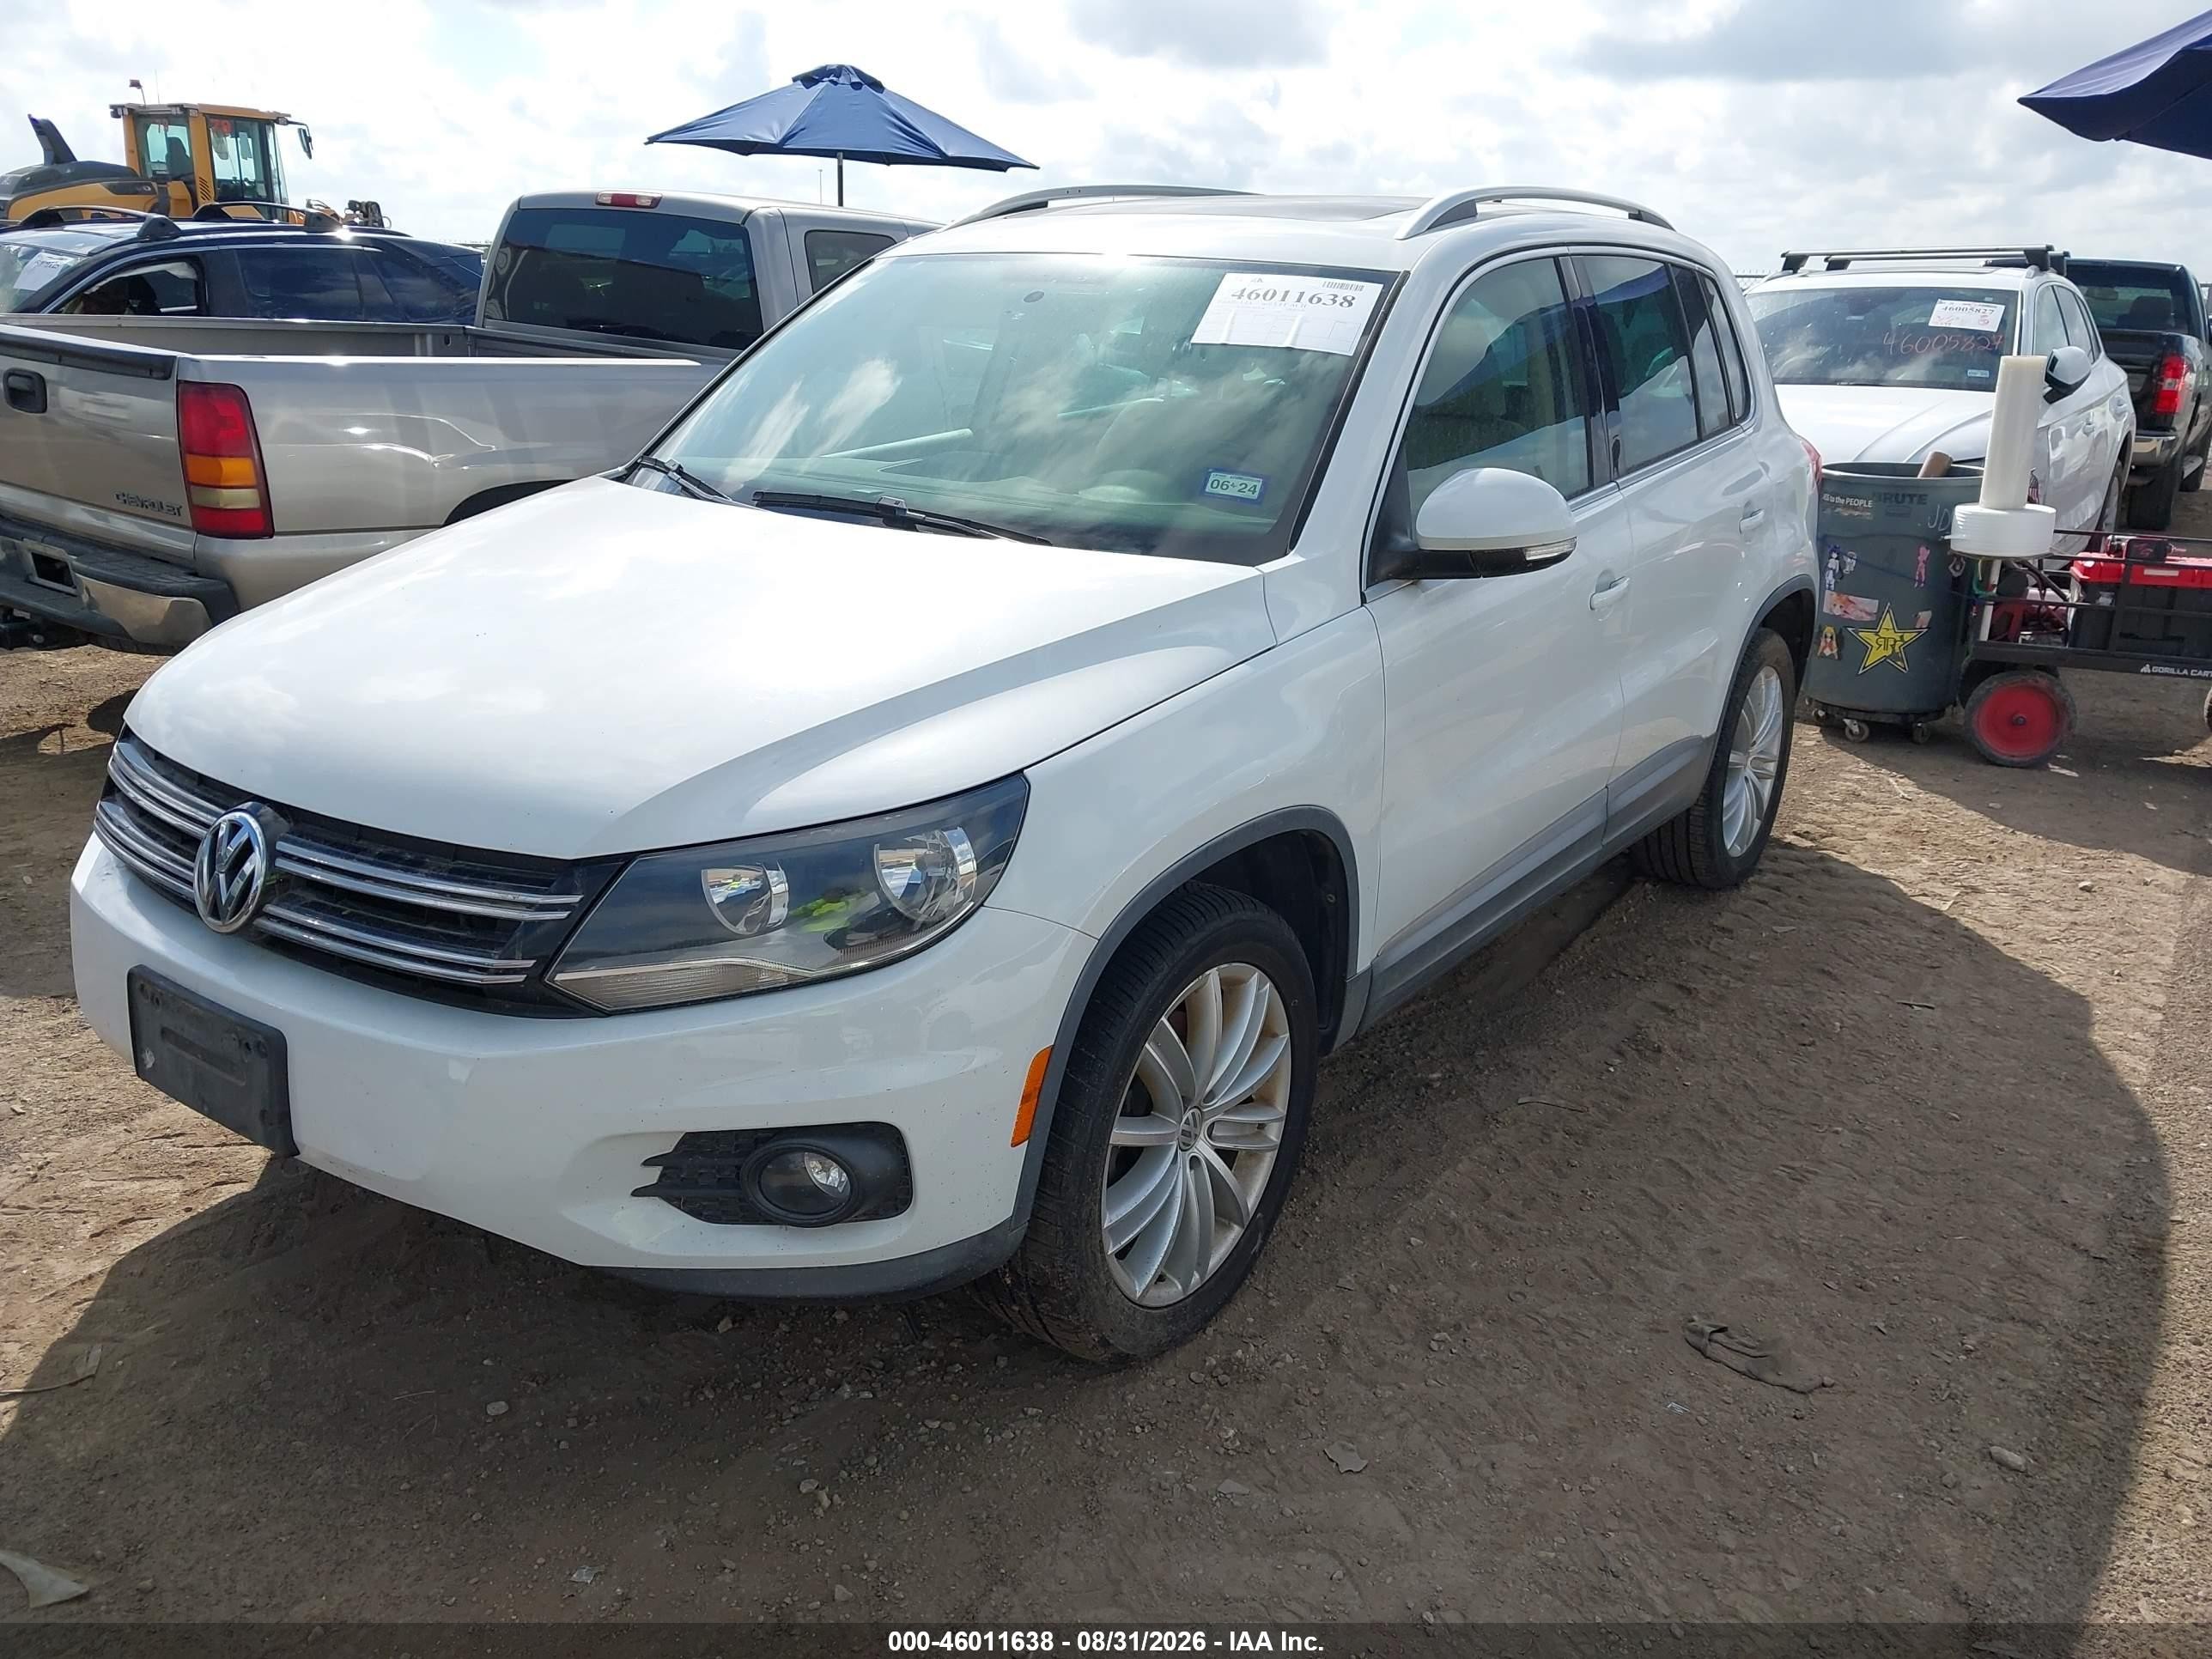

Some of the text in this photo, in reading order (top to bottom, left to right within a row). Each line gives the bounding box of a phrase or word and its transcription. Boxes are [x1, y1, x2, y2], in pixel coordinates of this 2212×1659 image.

[1231, 287, 1356, 308] 46011638
[1942, 306, 1995, 315] 46005827
[115, 492, 183, 516] CHEVROLET
[1845, 497, 1874, 507] PEOPLE
[2152, 665, 2189, 676] GORILLA
